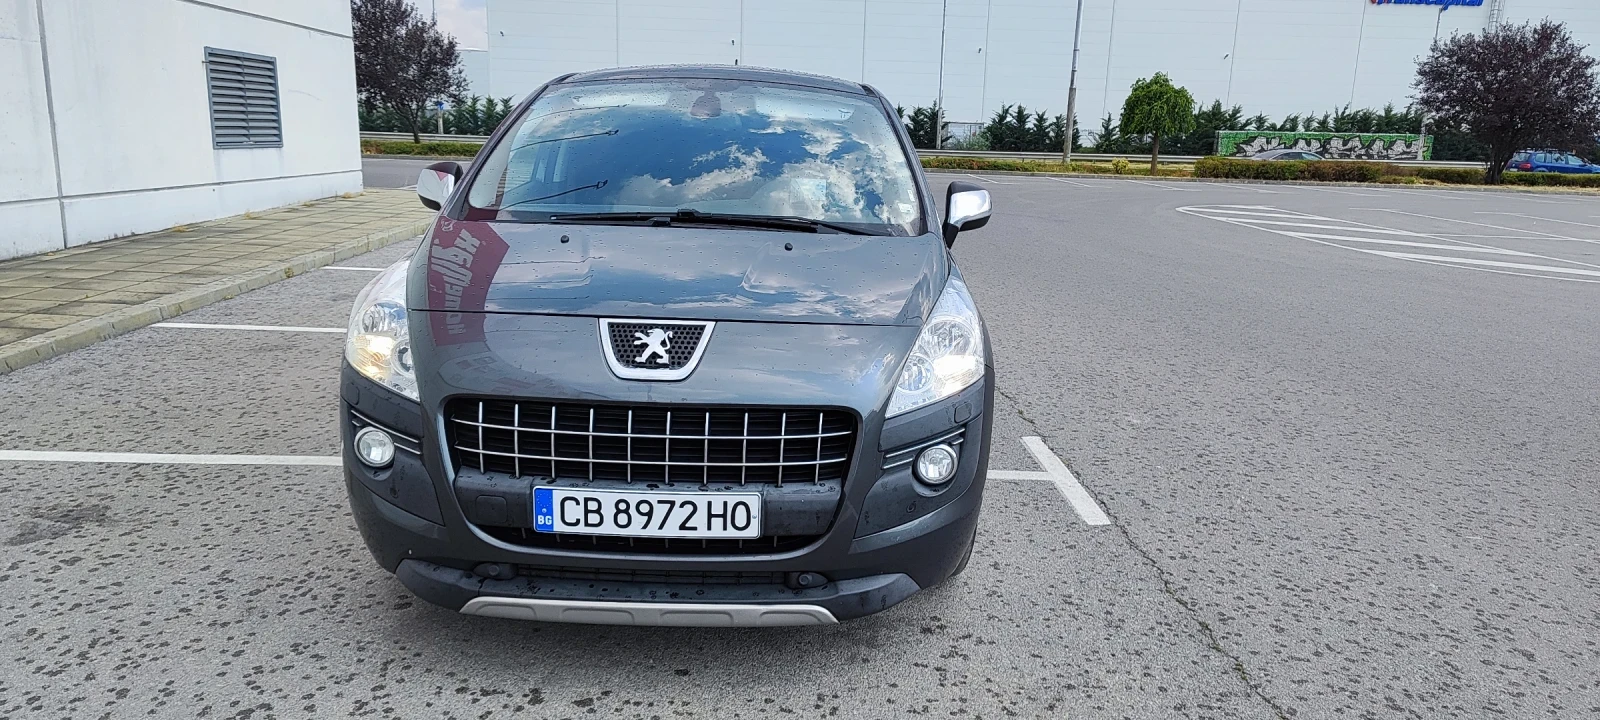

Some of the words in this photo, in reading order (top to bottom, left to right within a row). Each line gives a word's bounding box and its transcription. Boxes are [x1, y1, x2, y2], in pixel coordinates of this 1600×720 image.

[537, 515, 553, 526] BG
[560, 496, 605, 528] CB
[613, 498, 698, 531] 8972
[706, 500, 752, 532] HO
